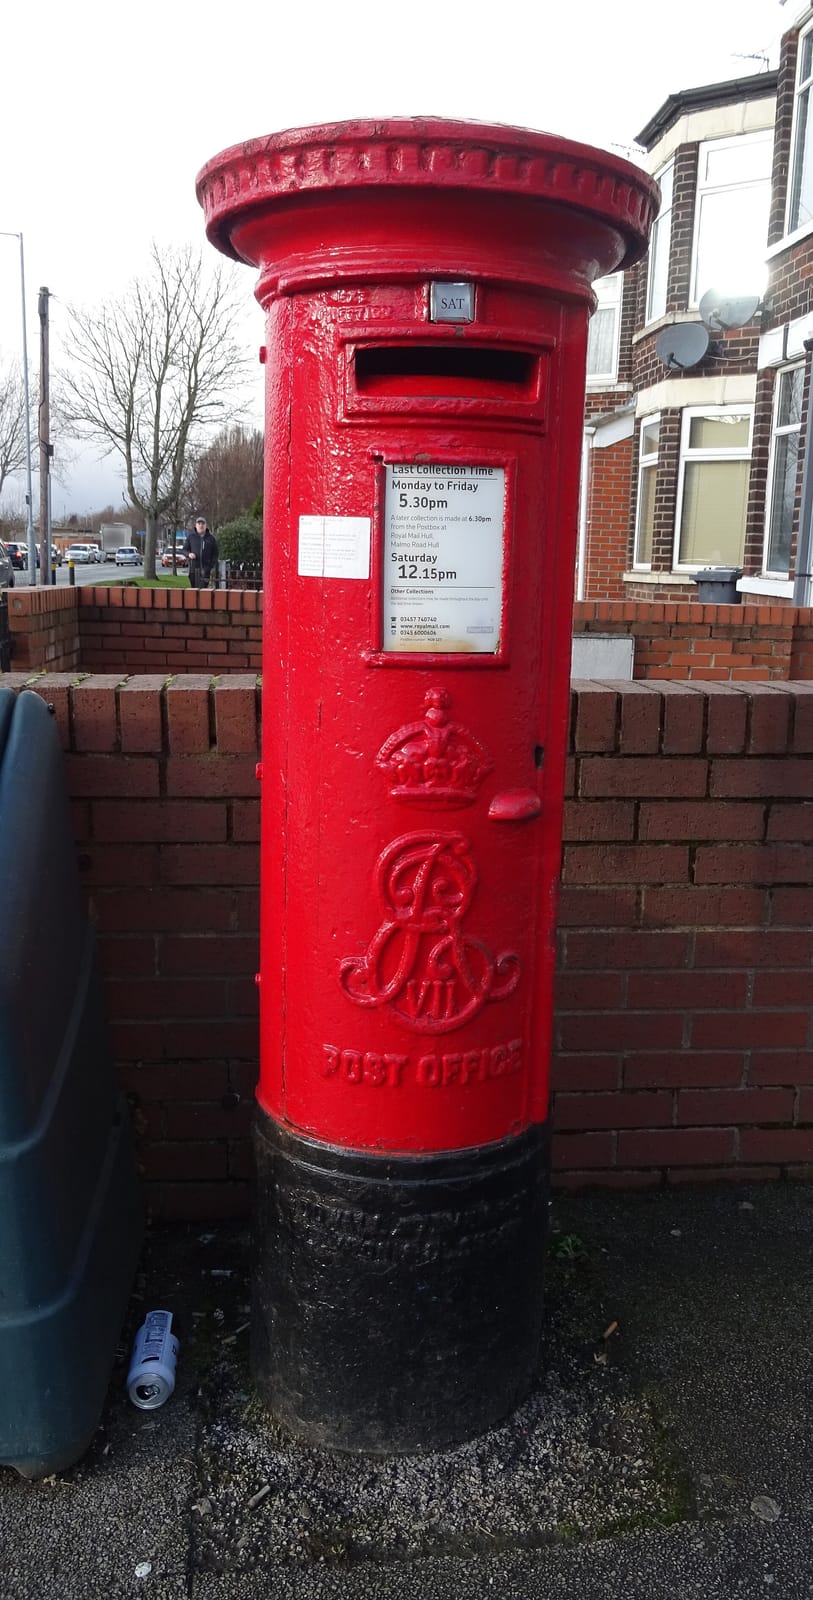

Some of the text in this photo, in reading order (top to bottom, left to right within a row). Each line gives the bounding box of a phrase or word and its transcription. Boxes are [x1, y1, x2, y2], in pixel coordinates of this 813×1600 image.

[440, 298, 465, 310] SAT
[392, 464, 493, 476] Last Collection Time
[392, 480, 479, 493] Monday to Friday
[399, 493, 448, 510] 5.30pm
[410, 514, 438, 522] collection
[468, 515, 492, 523] 6.30pm
[417, 523, 440, 531] Postbox
[391, 532, 406, 540] Royal
[407, 532, 420, 540] Mail
[427, 541, 440, 549] Hull
[391, 552, 438, 564] Saturday
[398, 564, 457, 581] 12.15pm
[322, 1038, 522, 1088] POST OFFICE
